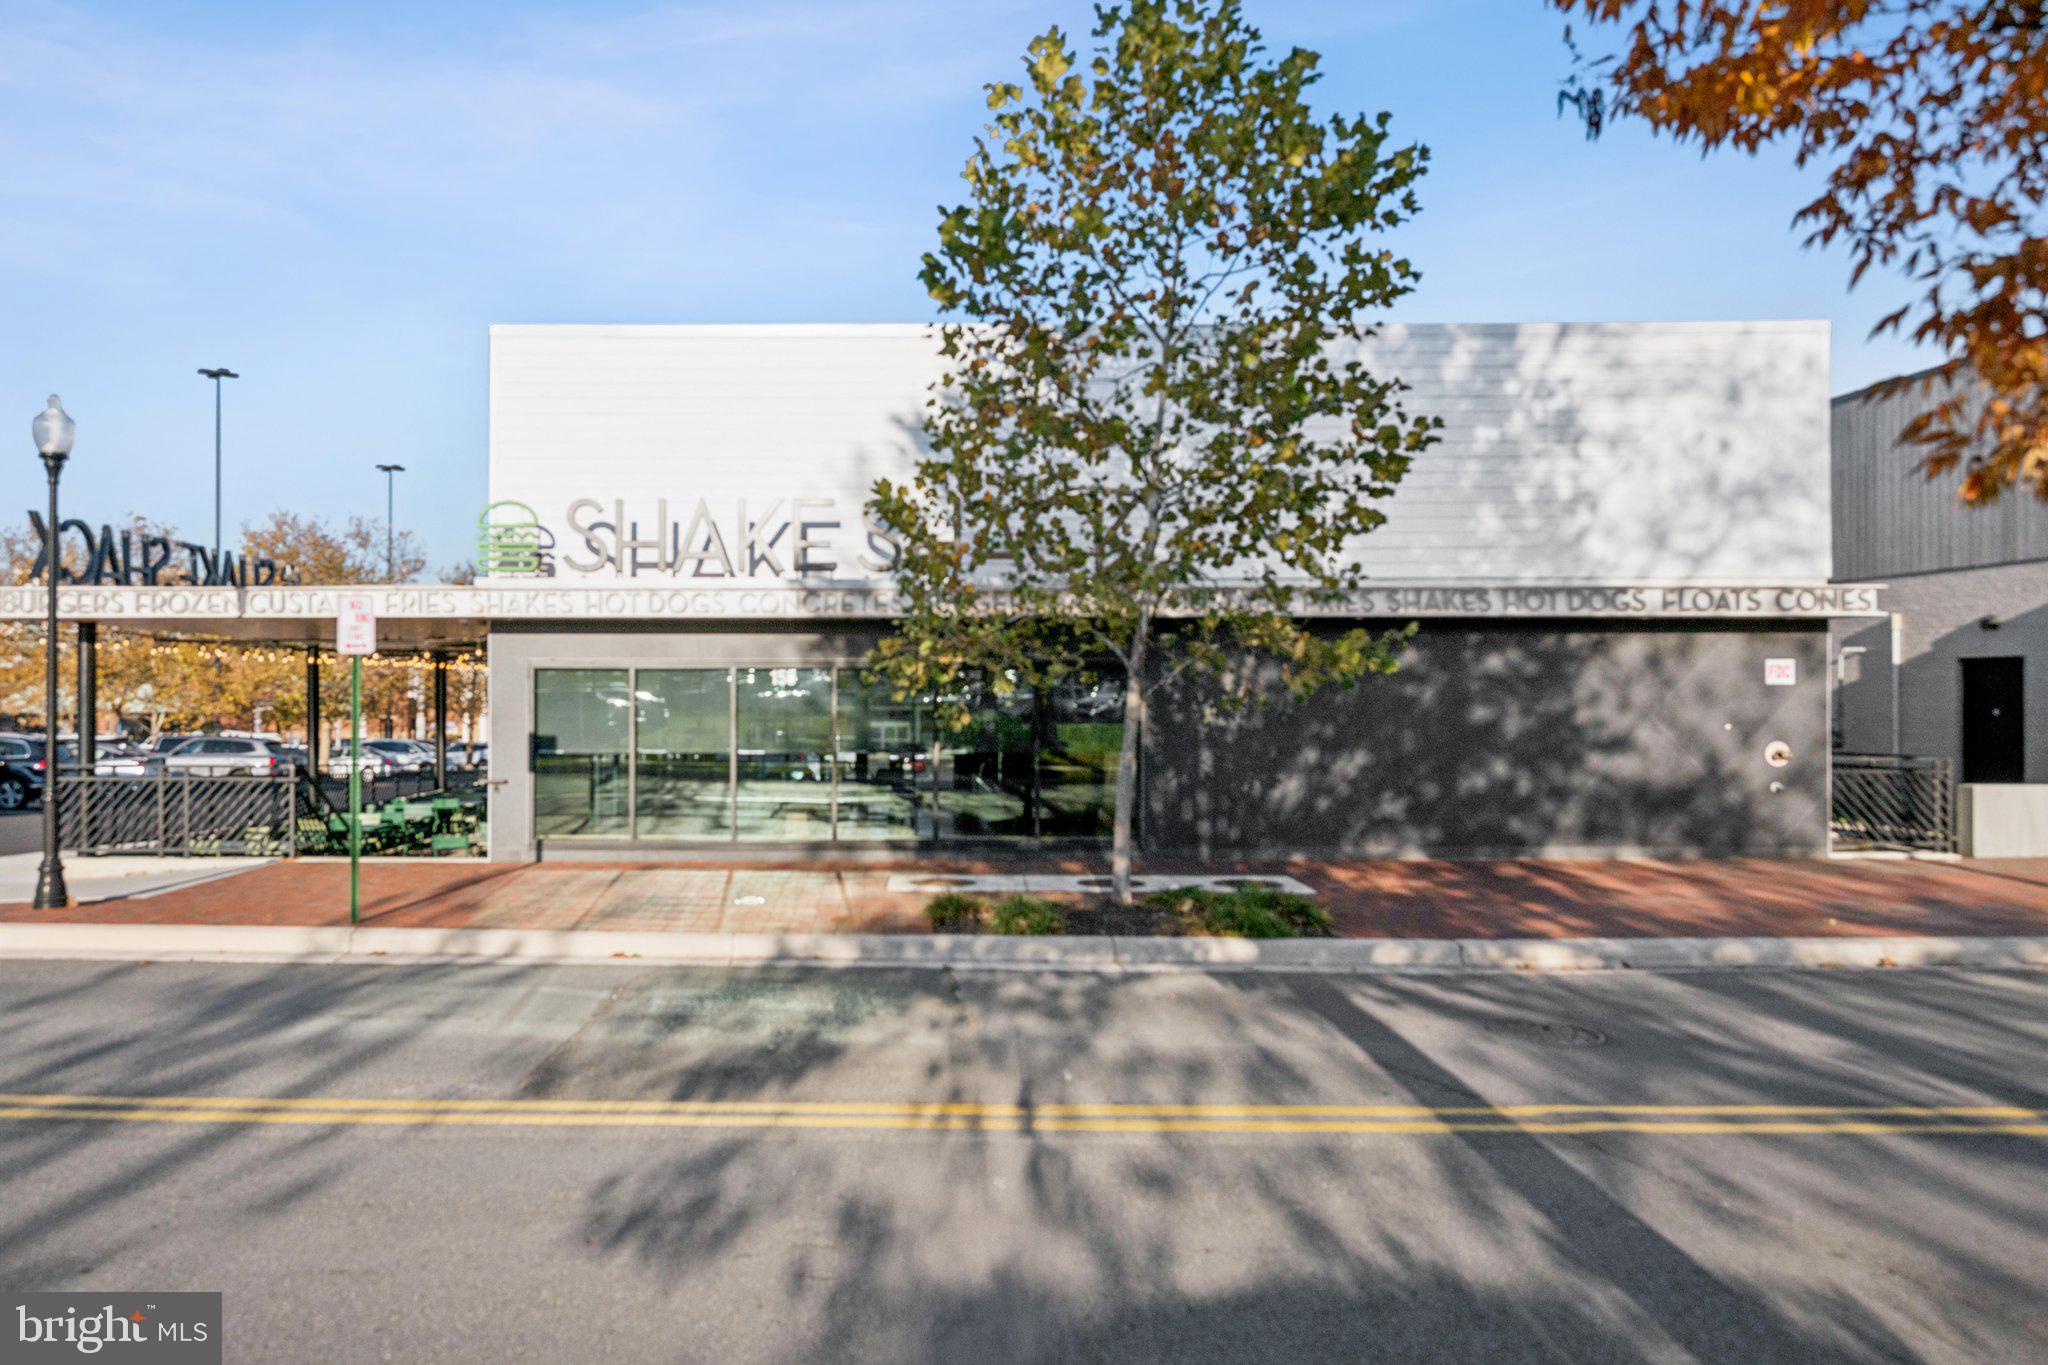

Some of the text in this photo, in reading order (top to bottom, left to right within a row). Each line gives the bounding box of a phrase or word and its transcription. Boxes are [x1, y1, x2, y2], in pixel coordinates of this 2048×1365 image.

[563, 498, 836, 573] SHAKE
[135, 590, 240, 614] FROZEN
[250, 590, 334, 614] CUSTA
[386, 591, 456, 613] FRIES
[471, 590, 574, 614] SHAKES
[1389, 587, 1492, 612] SHAKES
[1661, 588, 1761, 612] FLOATS
[1775, 588, 1871, 612] CONES
